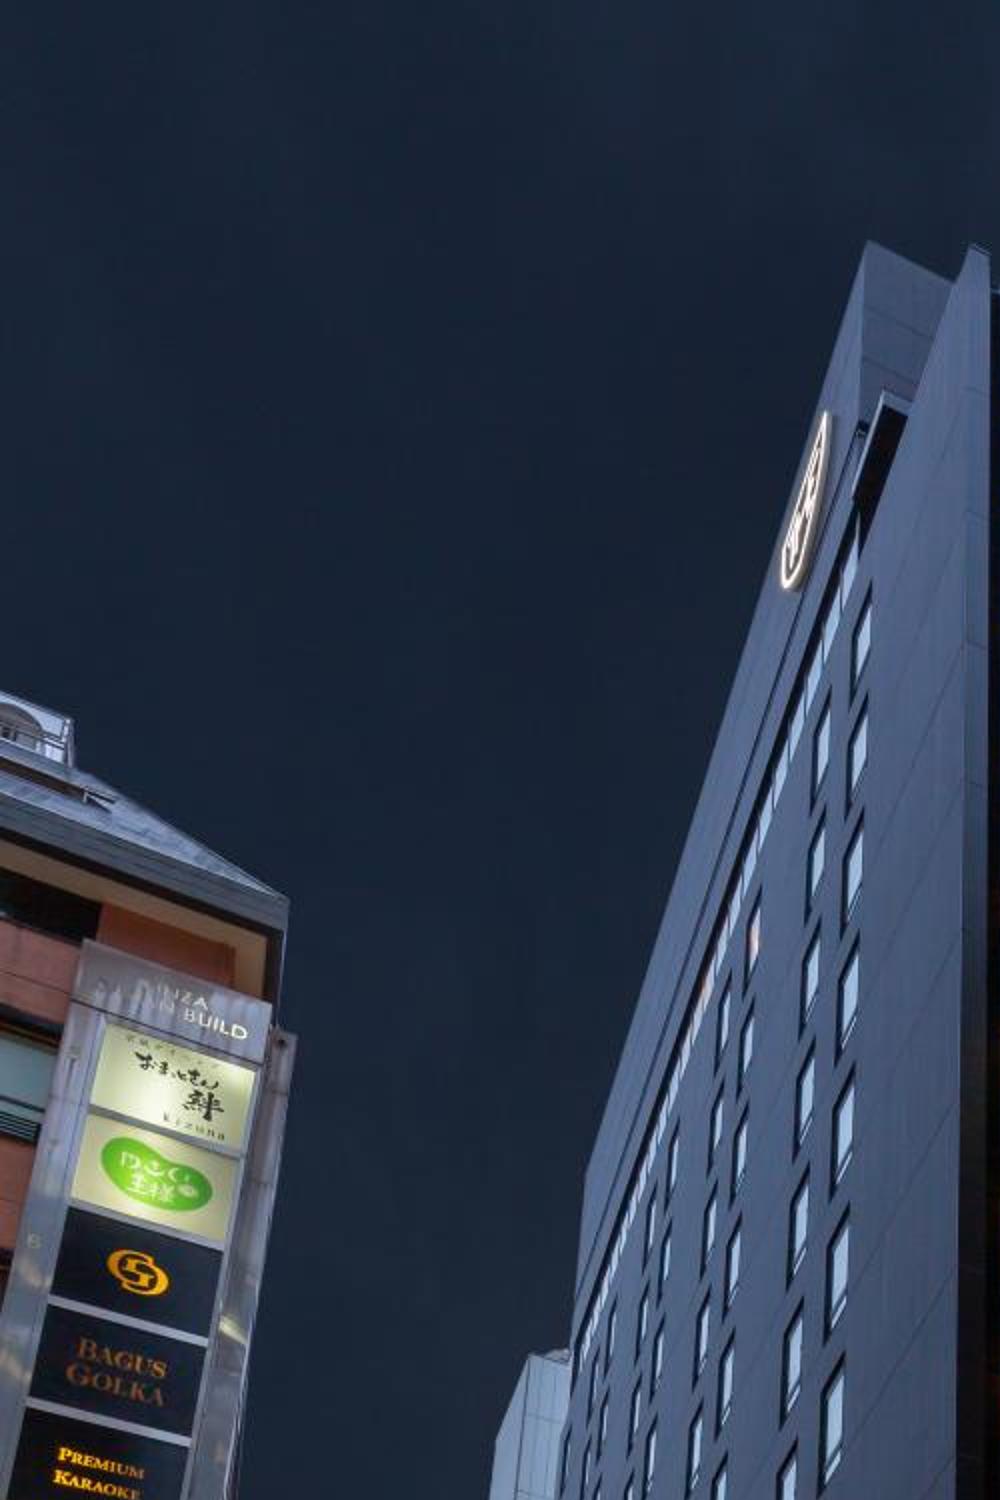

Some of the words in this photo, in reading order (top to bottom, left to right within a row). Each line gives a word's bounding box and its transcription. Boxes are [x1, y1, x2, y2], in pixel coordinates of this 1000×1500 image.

[183, 1007, 249, 1040] BUILD
[77, 1336, 168, 1380] BAGUS
[57, 1446, 145, 1480] PREMIUM
